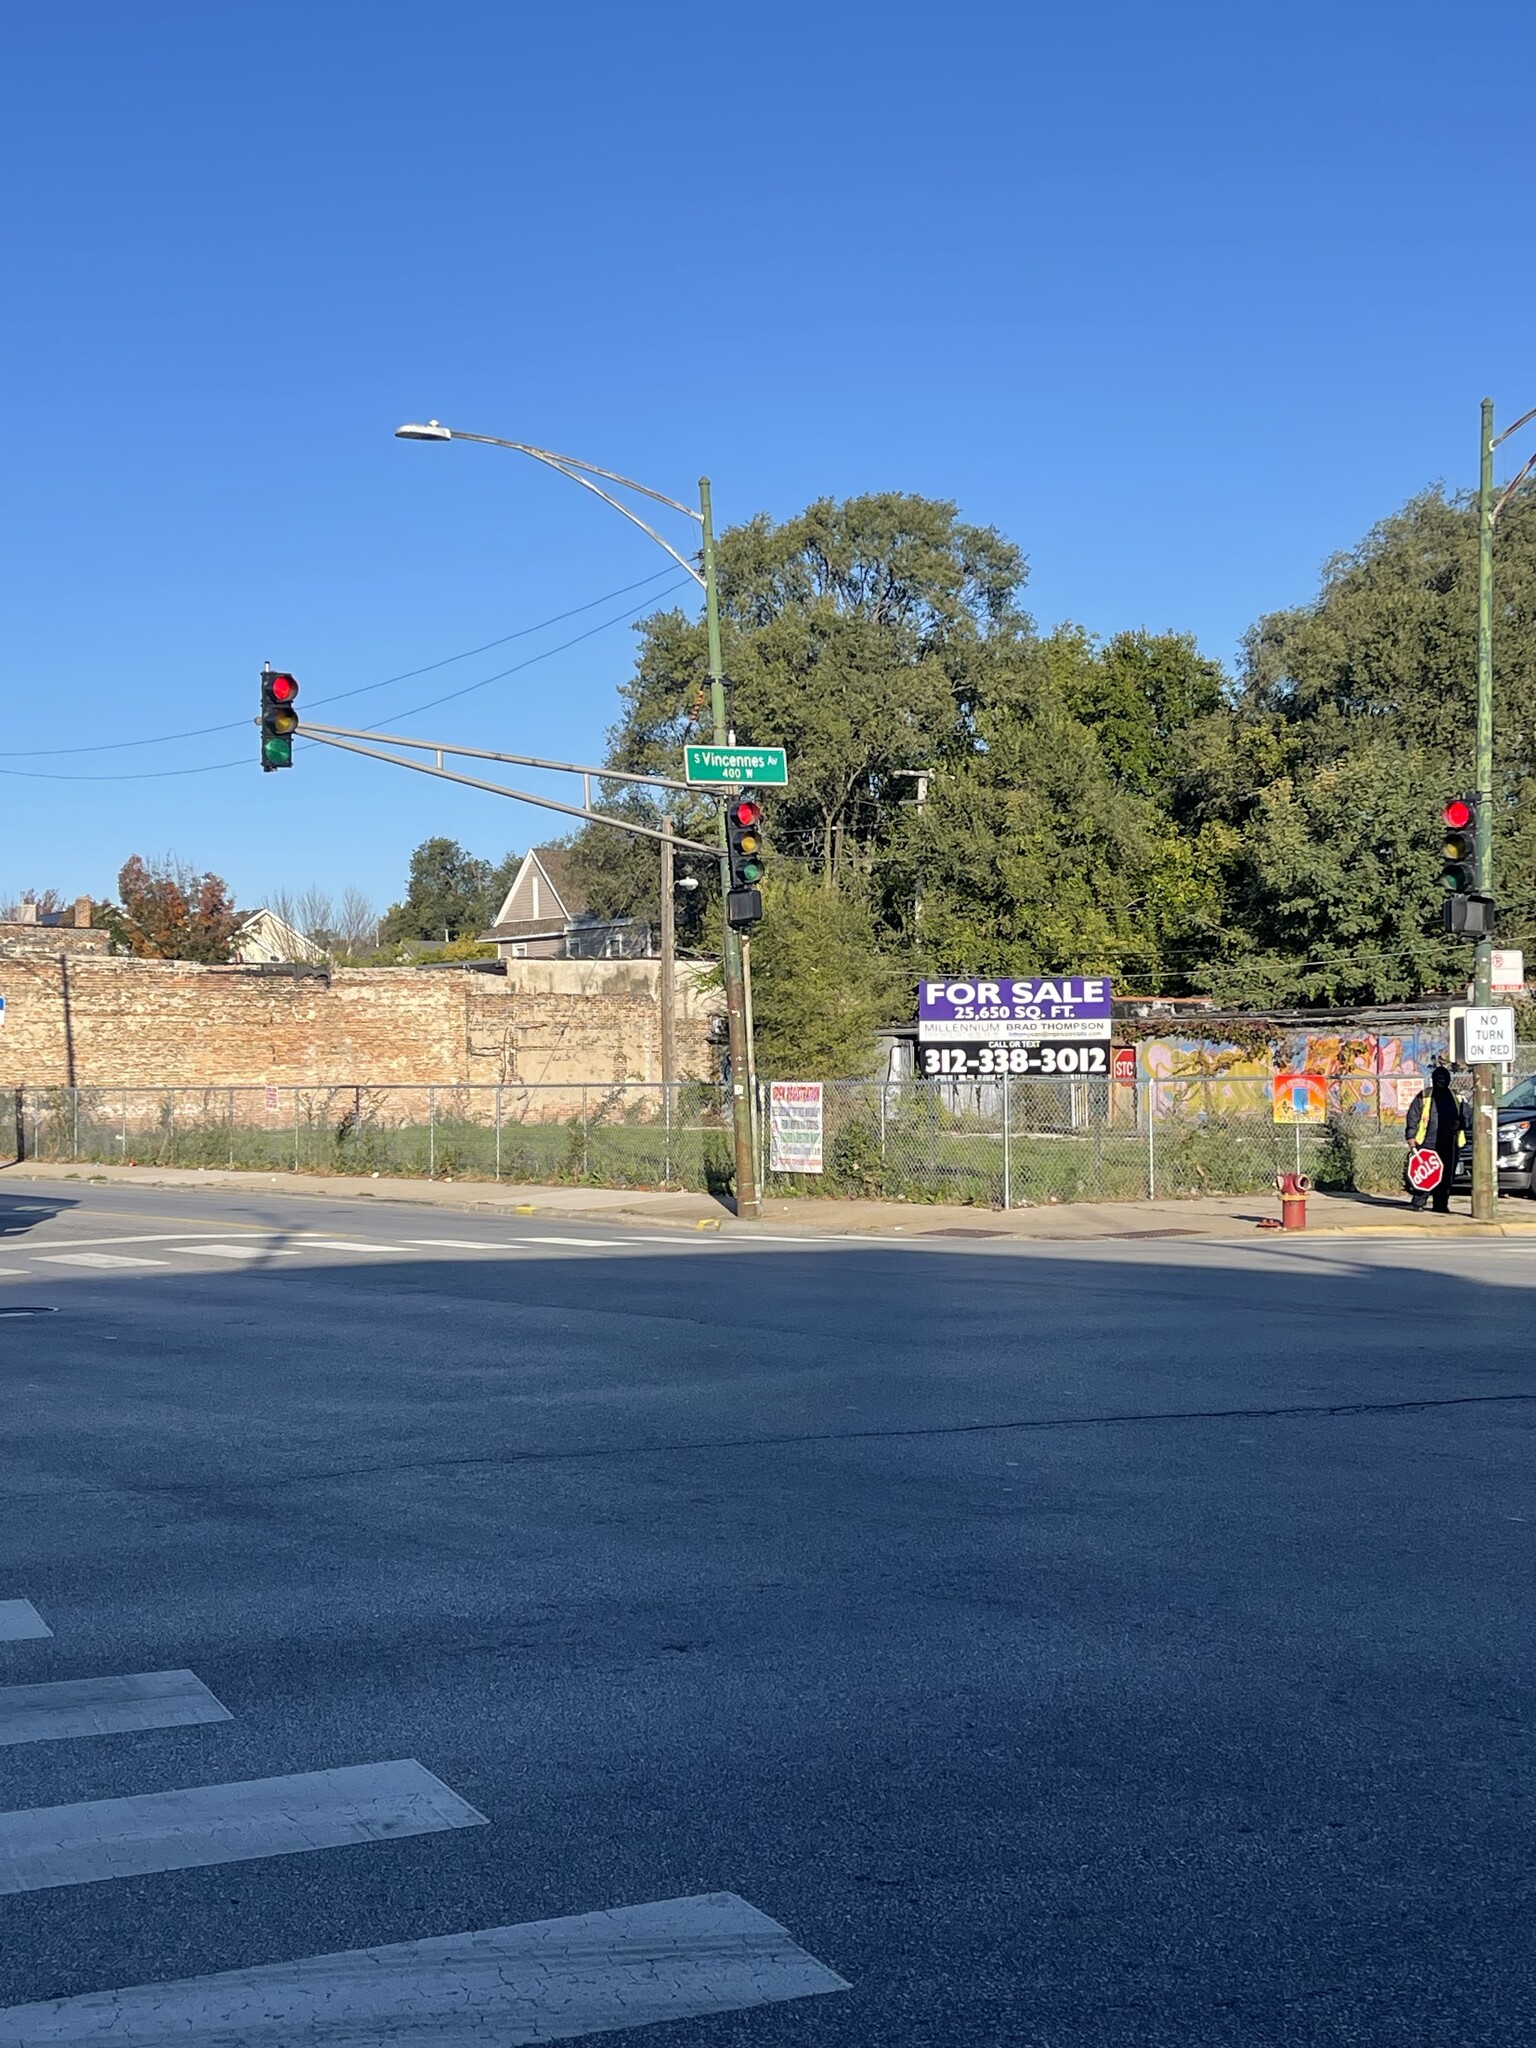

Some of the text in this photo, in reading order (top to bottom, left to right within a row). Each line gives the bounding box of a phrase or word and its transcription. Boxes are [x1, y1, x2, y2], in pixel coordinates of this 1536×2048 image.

[693, 752, 778, 768] S Vincennes Av
[722, 768, 753, 779] 400 W
[926, 981, 1105, 1005] FOR SALE
[954, 1005, 1076, 1021] 25,650 SQ. FT.
[1480, 1015, 1498, 1026] NO
[924, 1023, 1000, 1032] MILLENNIUM
[1006, 1022, 1104, 1031] BRAD THOMPSON
[1476, 1029, 1504, 1040] TURN
[988, 1041, 1008, 1049] CALL
[1021, 1040, 1041, 1048] TEXT
[1470, 1044, 1510, 1056] ON RED
[924, 1047, 1107, 1073] 312-338-3012
[1413, 1155, 1440, 1185] STOP
